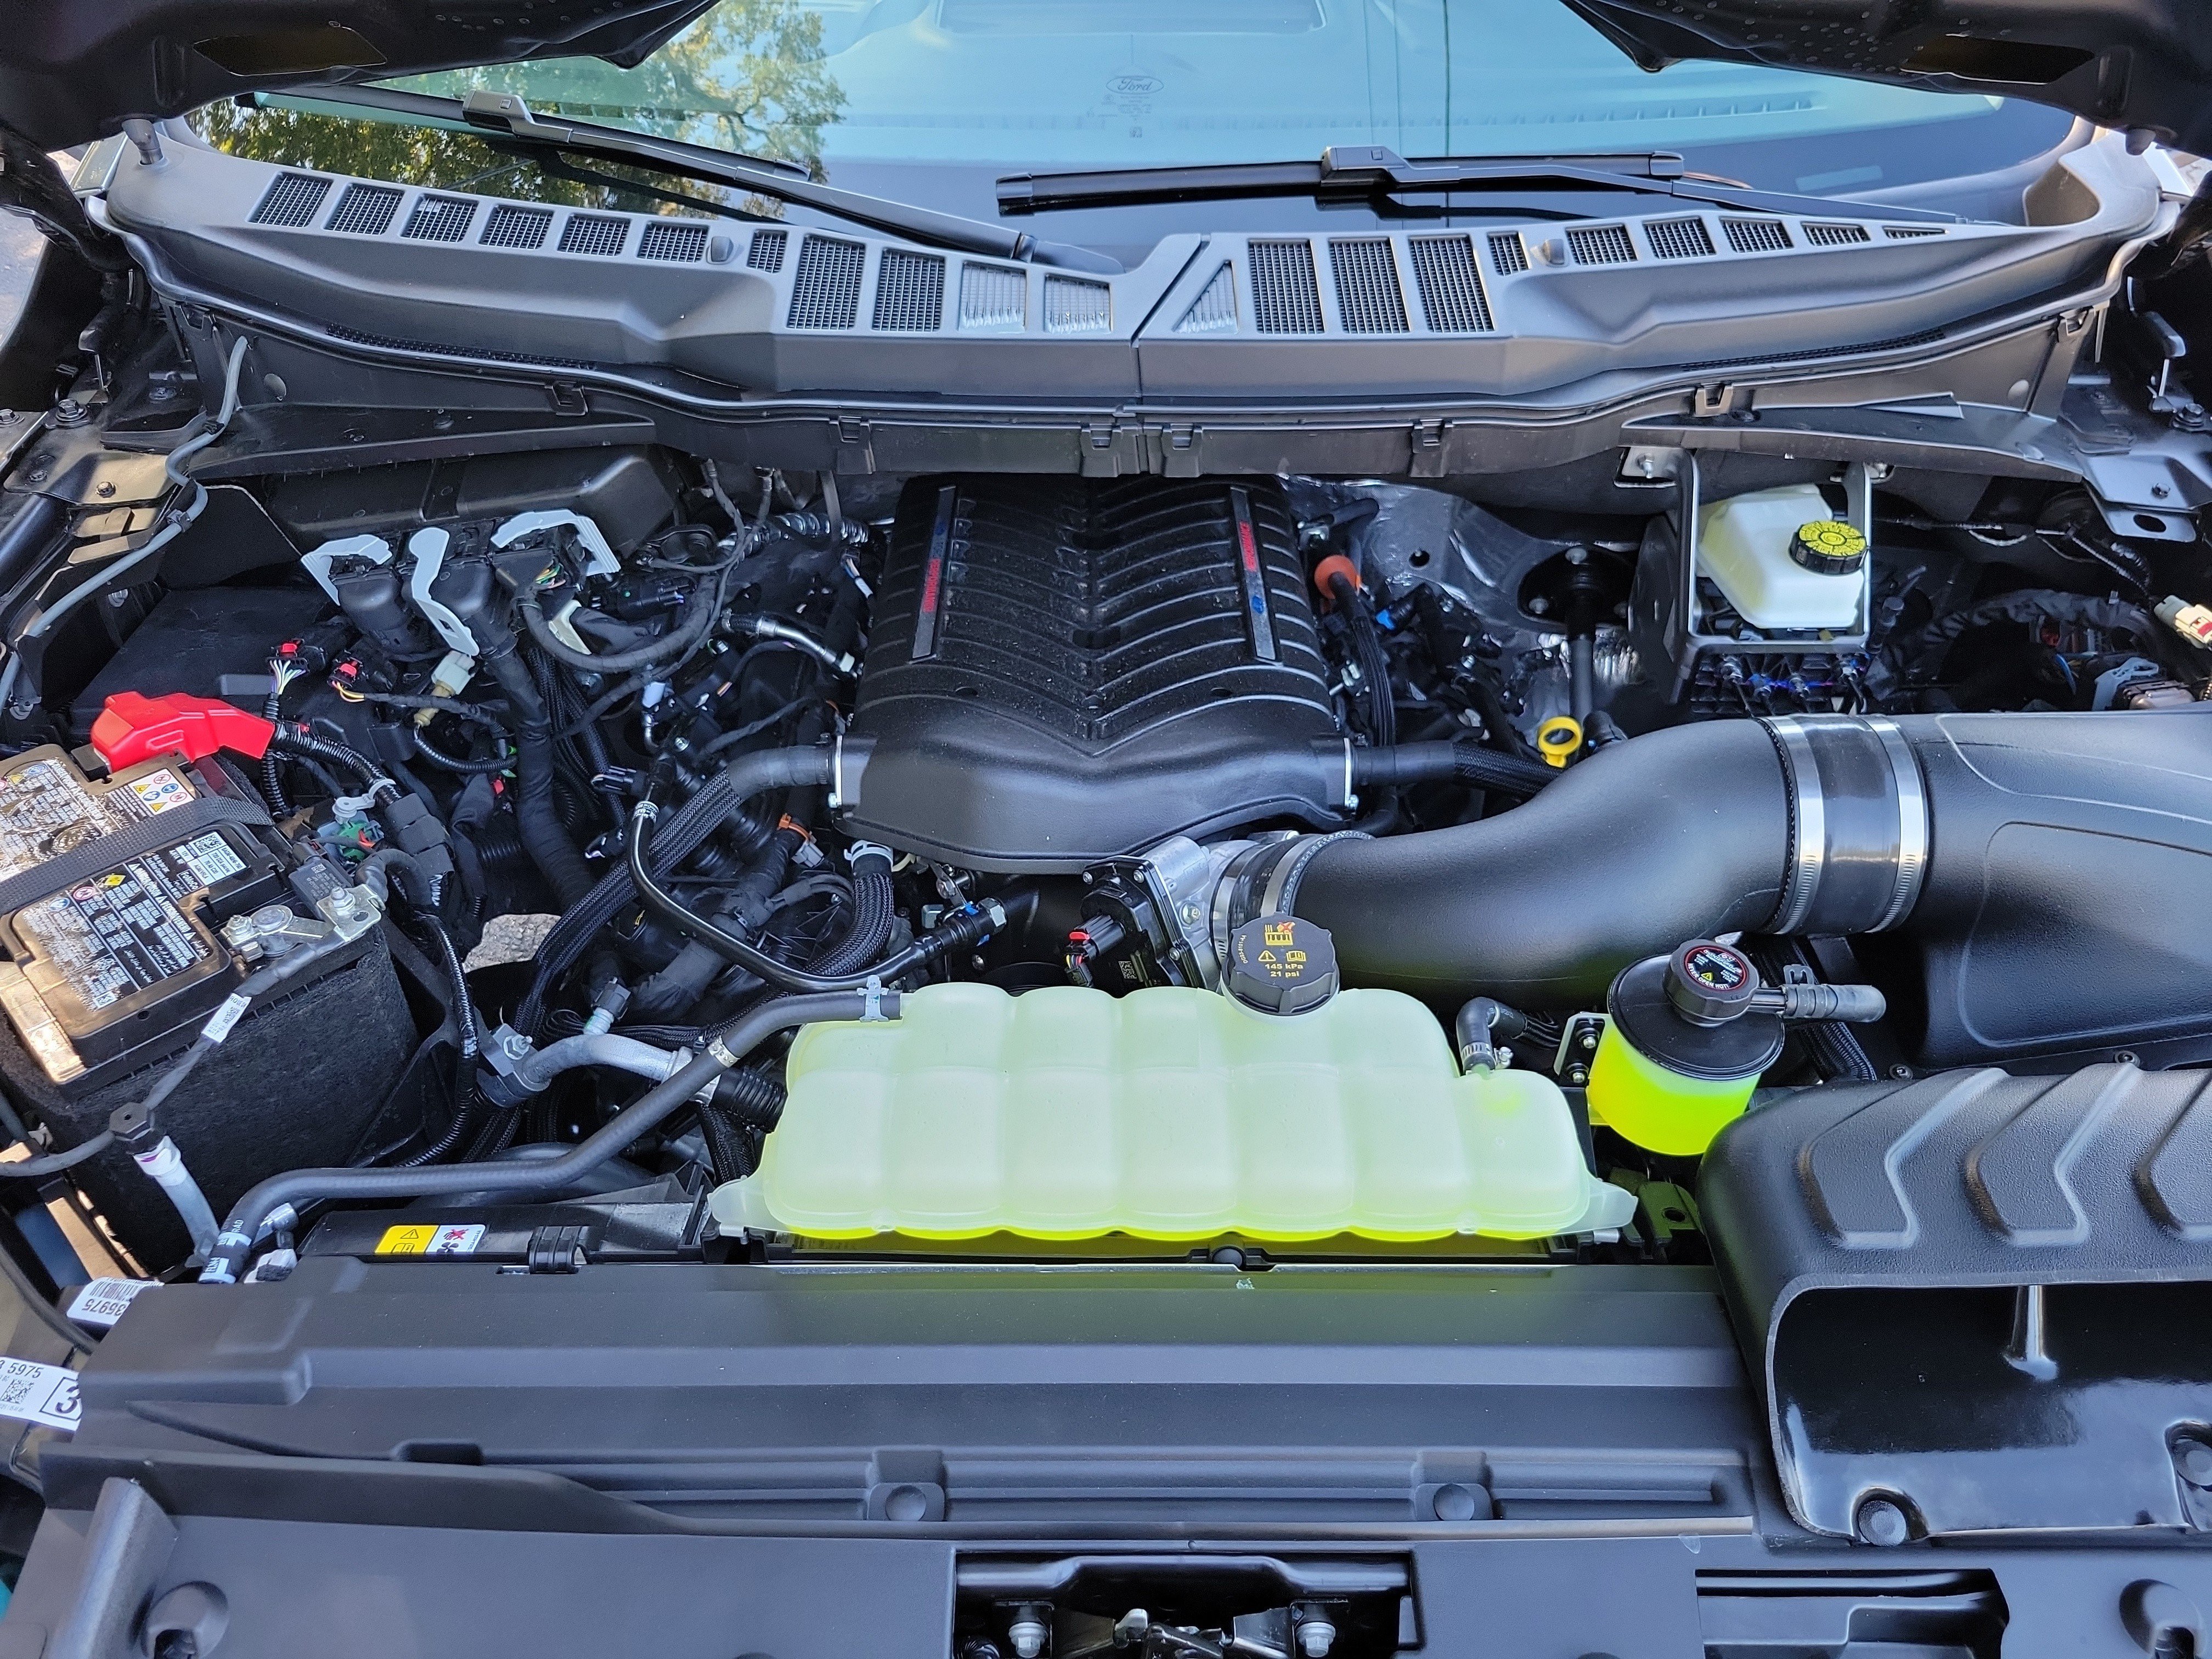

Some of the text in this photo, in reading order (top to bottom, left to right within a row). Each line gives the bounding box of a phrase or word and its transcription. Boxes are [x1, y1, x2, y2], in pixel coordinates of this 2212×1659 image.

[1118, 77, 1153, 91] Ford
[178, 871, 201, 890] FoMoCo
[1688, 963, 1700, 978] NEVER
[1698, 977, 1714, 987] OPEN
[231, 1220, 244, 1233] RAD
[81, 1299, 126, 1316] 35975
[7, 1363, 44, 1378] 5975
[55, 1386, 82, 1415] 3
